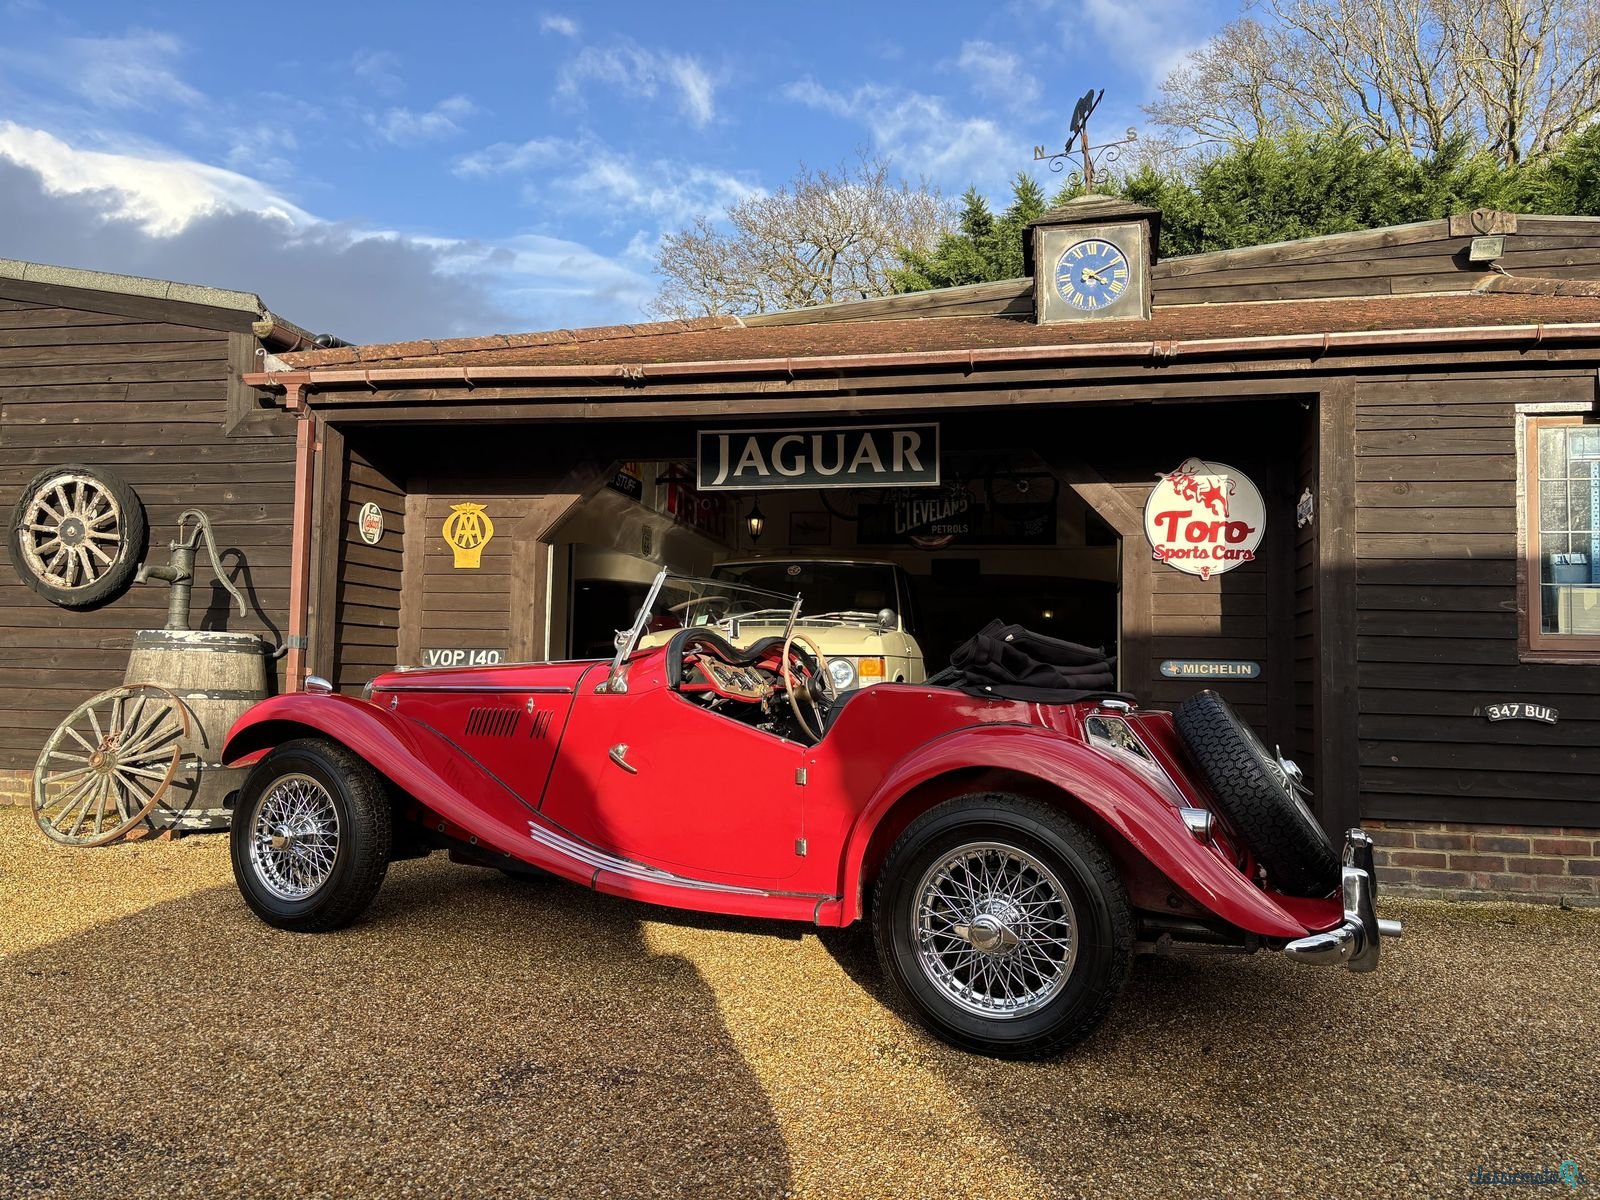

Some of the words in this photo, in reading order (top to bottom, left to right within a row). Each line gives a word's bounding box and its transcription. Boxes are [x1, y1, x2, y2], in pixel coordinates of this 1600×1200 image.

[711, 430, 925, 486] JAGUAR
[894, 498, 969, 535] CLEVELAND
[931, 523, 969, 535] PETROLS
[1154, 510, 1256, 544] Toro
[1154, 544, 1209, 562] Sports
[1212, 546, 1255, 561] Cars
[429, 649, 465, 666] VOP
[469, 649, 500, 666] 140
[1183, 663, 1252, 675] MICHELIN
[1489, 705, 1520, 719] 347
[1525, 705, 1555, 722] BUL
